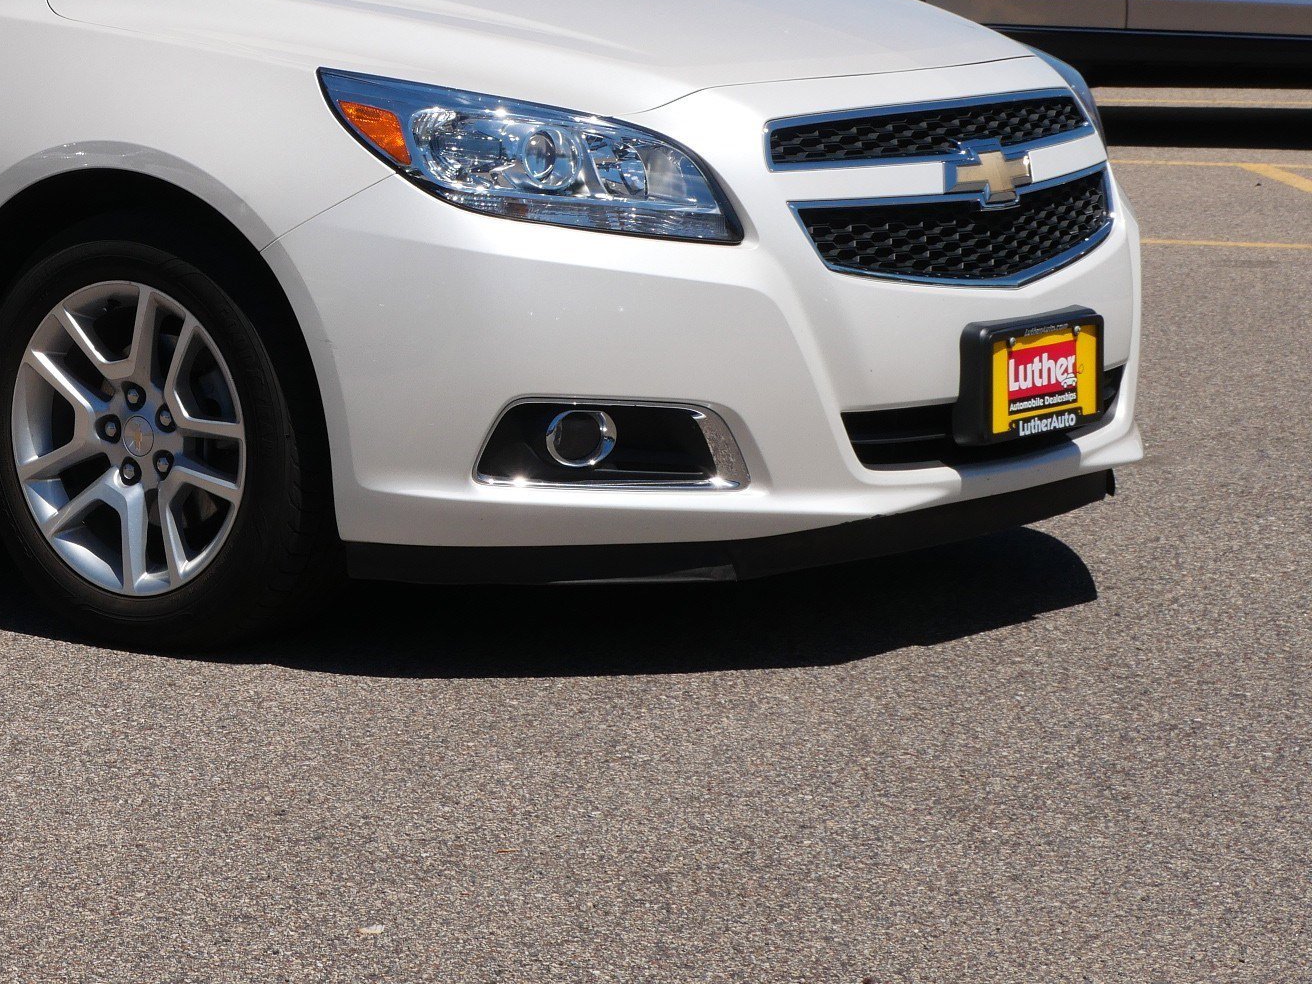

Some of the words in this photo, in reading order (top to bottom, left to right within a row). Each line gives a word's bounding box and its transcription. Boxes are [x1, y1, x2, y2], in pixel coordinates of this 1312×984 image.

[1009, 353, 1076, 391] Luther
[1009, 398, 1044, 412] Automobile
[1045, 392, 1077, 405] Dealerships
[1019, 413, 1076, 436] LutherAuto
